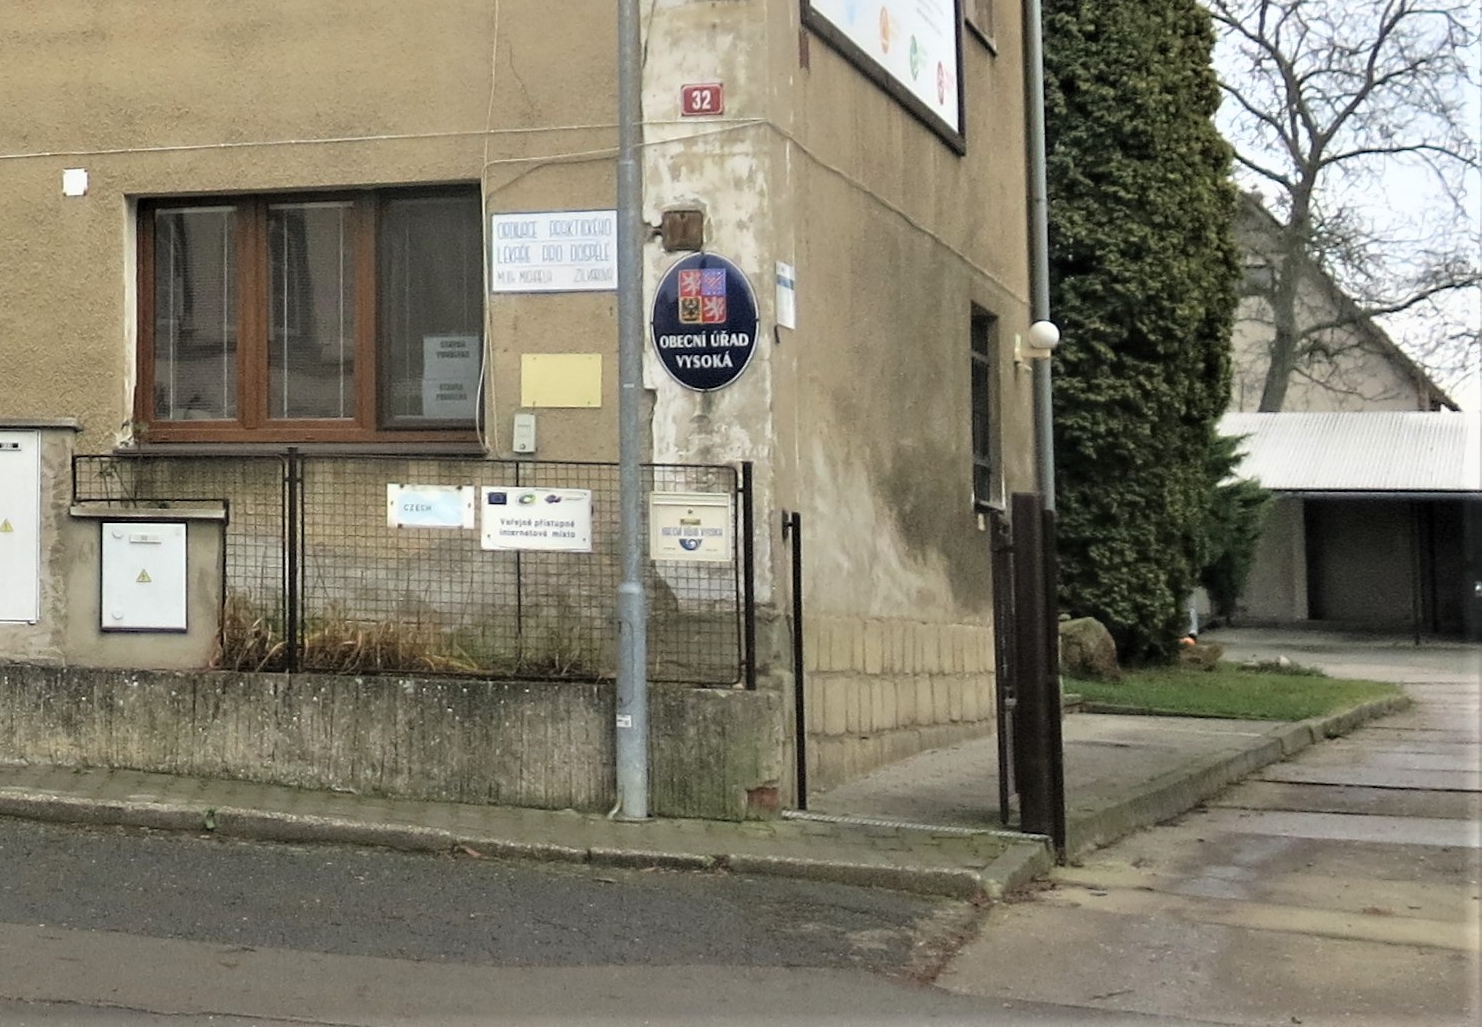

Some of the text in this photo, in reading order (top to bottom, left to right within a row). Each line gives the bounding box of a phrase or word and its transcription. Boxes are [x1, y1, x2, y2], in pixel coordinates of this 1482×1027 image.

[692, 90, 712, 110] 32
[542, 244, 563, 262] PRO
[659, 330, 750, 348] OBECNÍ ÚŘAD
[675, 351, 734, 369] VYSOKÁ
[552, 529, 576, 539] místo
